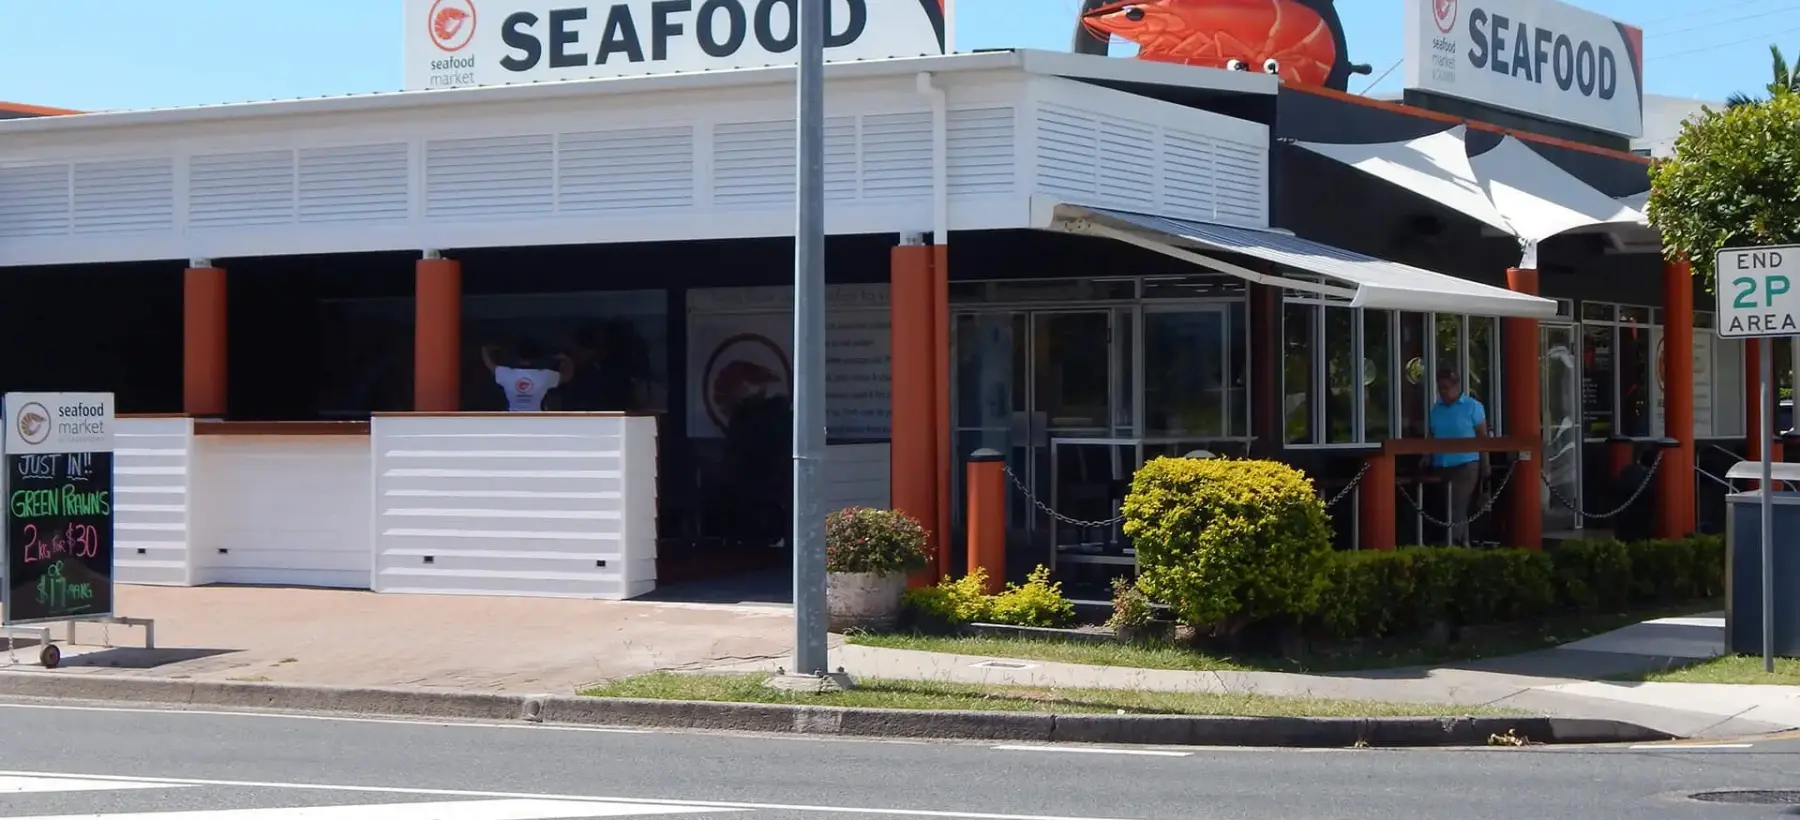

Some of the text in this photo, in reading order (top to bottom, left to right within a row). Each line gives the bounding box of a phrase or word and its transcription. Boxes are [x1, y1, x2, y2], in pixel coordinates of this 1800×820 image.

[500, 0, 867, 72] SEAFOOD
[1432, 36, 1456, 54] seafood
[430, 53, 475, 70] seafood
[1468, 7, 1617, 100] SEAFOOD
[430, 71, 475, 85] market
[1737, 252, 1783, 270] END
[1732, 275, 1791, 308] 2P
[1729, 313, 1797, 332] AREA
[59, 402, 104, 417] seafood
[59, 419, 104, 435] market
[18, 453, 61, 476] JUST
[11, 484, 110, 518] GREEN PRAWNS
[66, 522, 97, 558] $30
